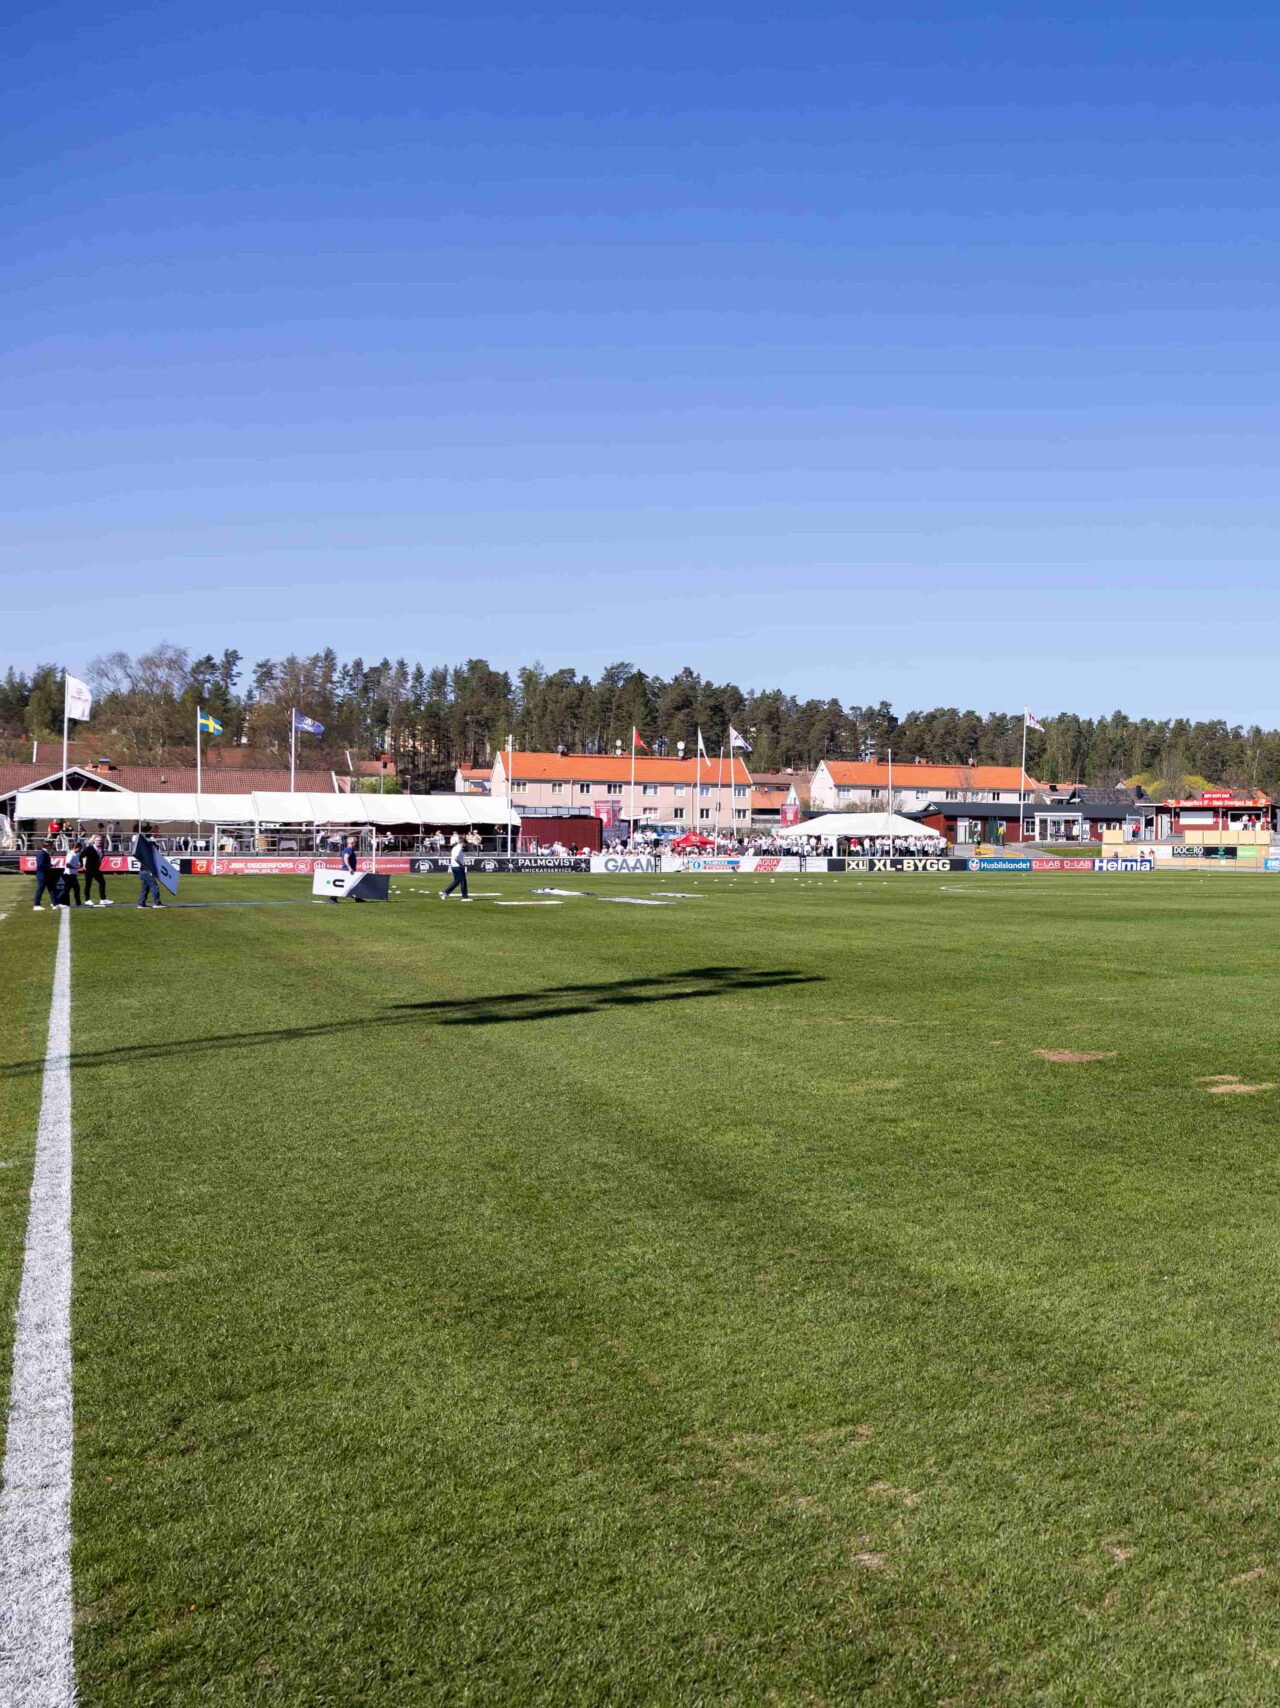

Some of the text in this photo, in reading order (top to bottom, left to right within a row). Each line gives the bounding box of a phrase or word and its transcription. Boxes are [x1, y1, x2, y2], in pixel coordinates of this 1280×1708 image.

[873, 859, 950, 871] XL-BYGG
[981, 861, 1030, 869] Husbilslandet
[1095, 859, 1150, 871] Helmia
